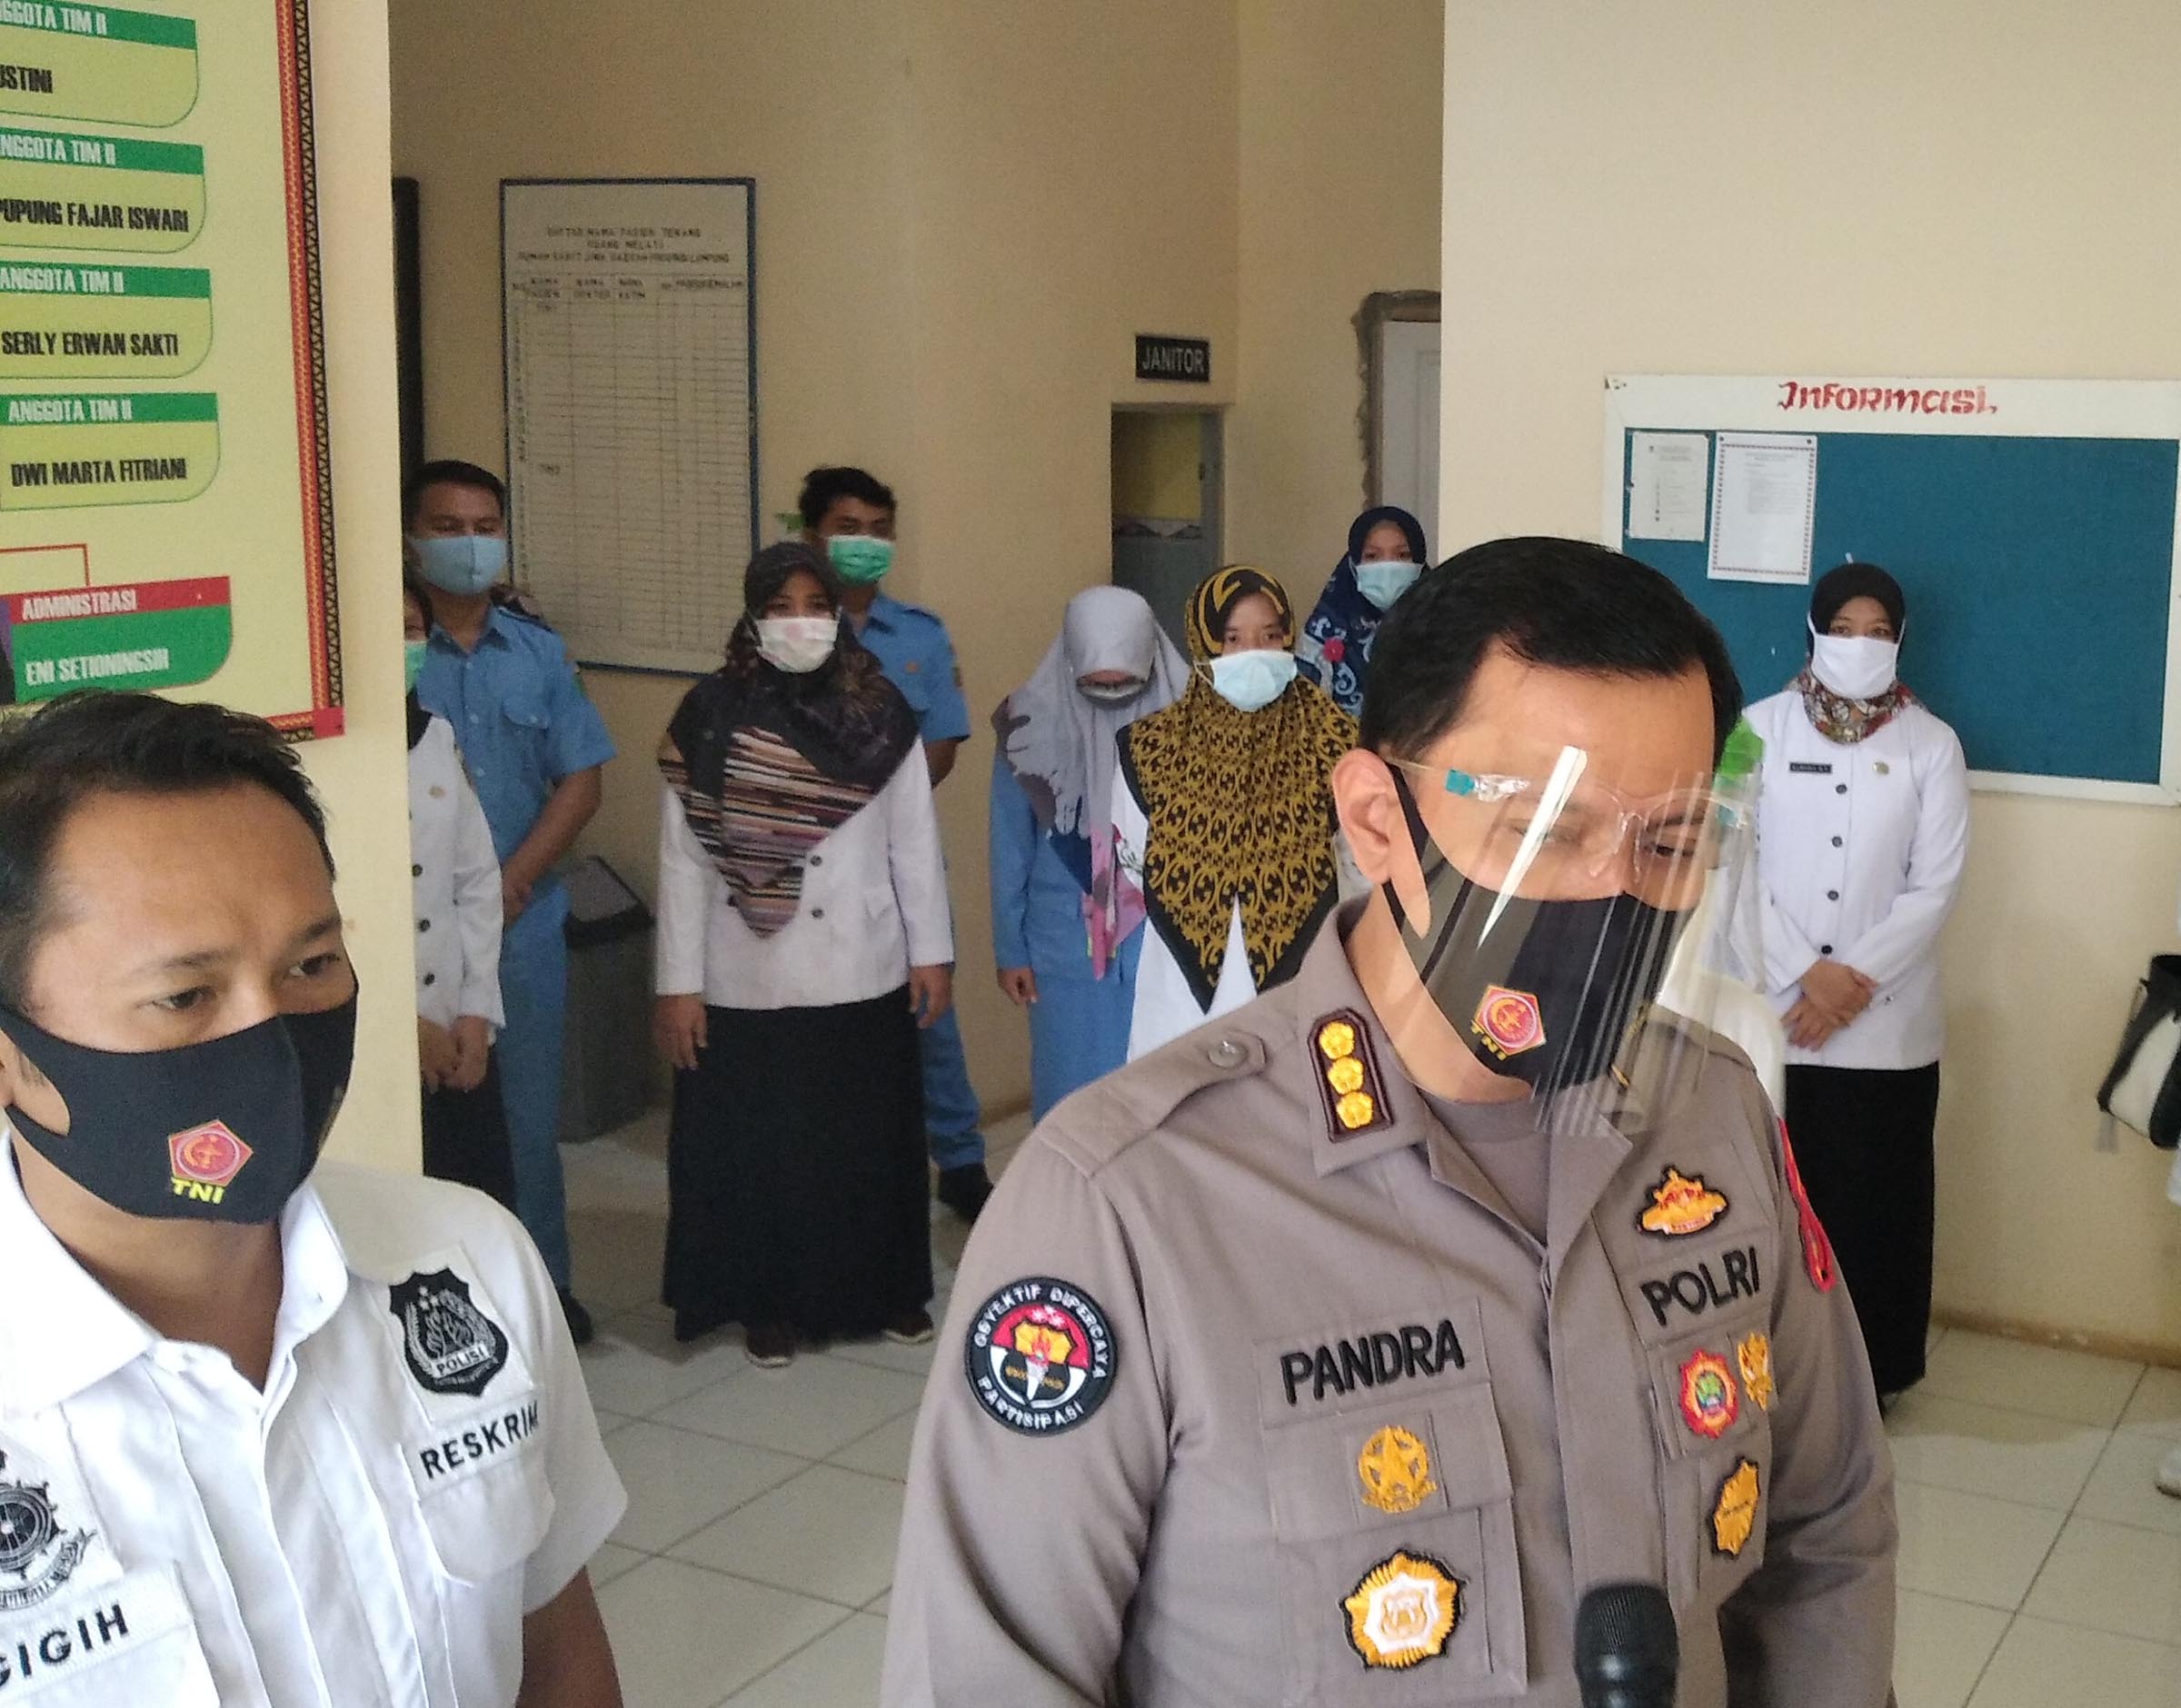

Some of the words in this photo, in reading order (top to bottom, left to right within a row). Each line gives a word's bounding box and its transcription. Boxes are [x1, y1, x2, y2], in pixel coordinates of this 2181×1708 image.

[0, 0, 57, 29] GGOTA
[60, 7, 92, 34] TIM
[70, 139, 102, 164] TIM
[67, 202, 124, 228] FAJAR
[128, 205, 189, 232] ISWARI
[0, 267, 76, 292] ANGGOTA
[80, 270, 110, 293] TIM
[2, 331, 56, 355] SERLY
[63, 332, 126, 355] ERWAN
[130, 333, 179, 355] SAKTI
[1141, 345, 1206, 374] JANITOR
[9, 400, 85, 422] ANGGOTA
[89, 400, 119, 421] TIM
[11, 462, 48, 487] DWI
[51, 461, 116, 485] MARTA
[119, 458, 187, 482] FITRIANI
[1469, 1018, 1508, 1062] TNI
[170, 1175, 225, 1206] TNI
[1638, 1245, 1761, 1328] POLRI
[436, 1346, 486, 1378] POLISI
[1280, 1318, 1467, 1408] PANDRA
